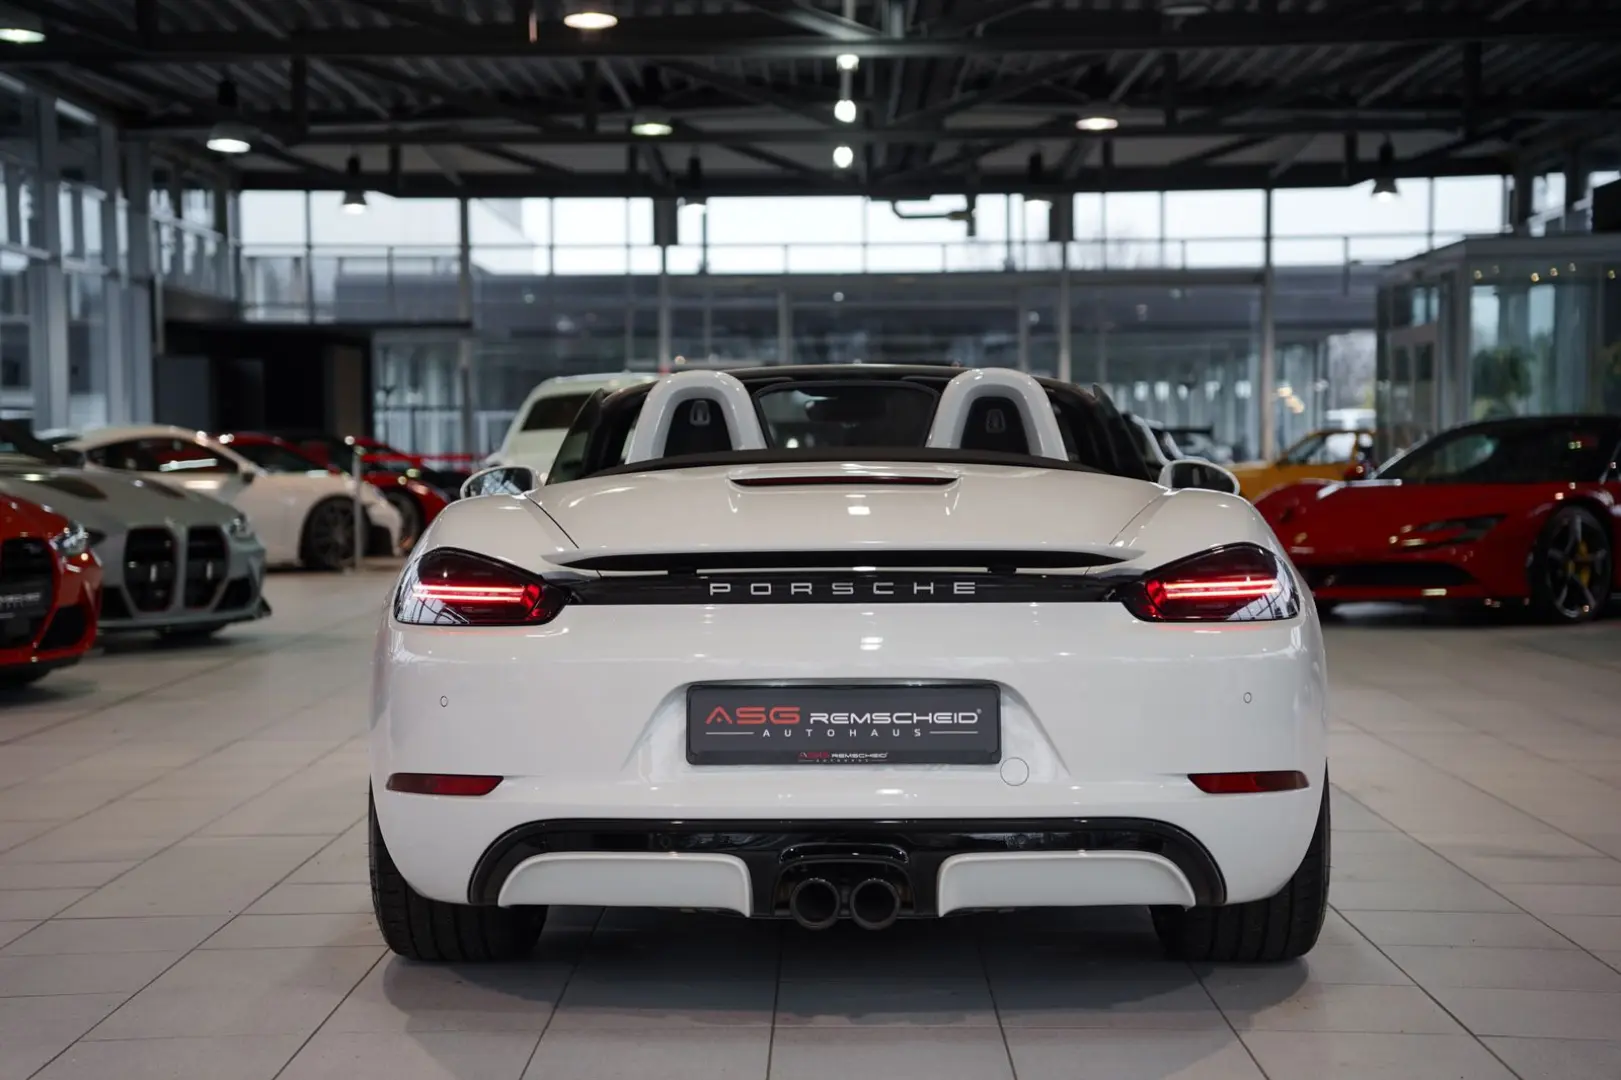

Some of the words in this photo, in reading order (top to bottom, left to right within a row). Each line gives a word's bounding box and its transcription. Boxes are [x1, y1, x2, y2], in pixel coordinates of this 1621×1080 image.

[709, 582, 976, 595] PORSCHE
[705, 706, 800, 724] ASG
[762, 728, 921, 737] AUTOHAUS
